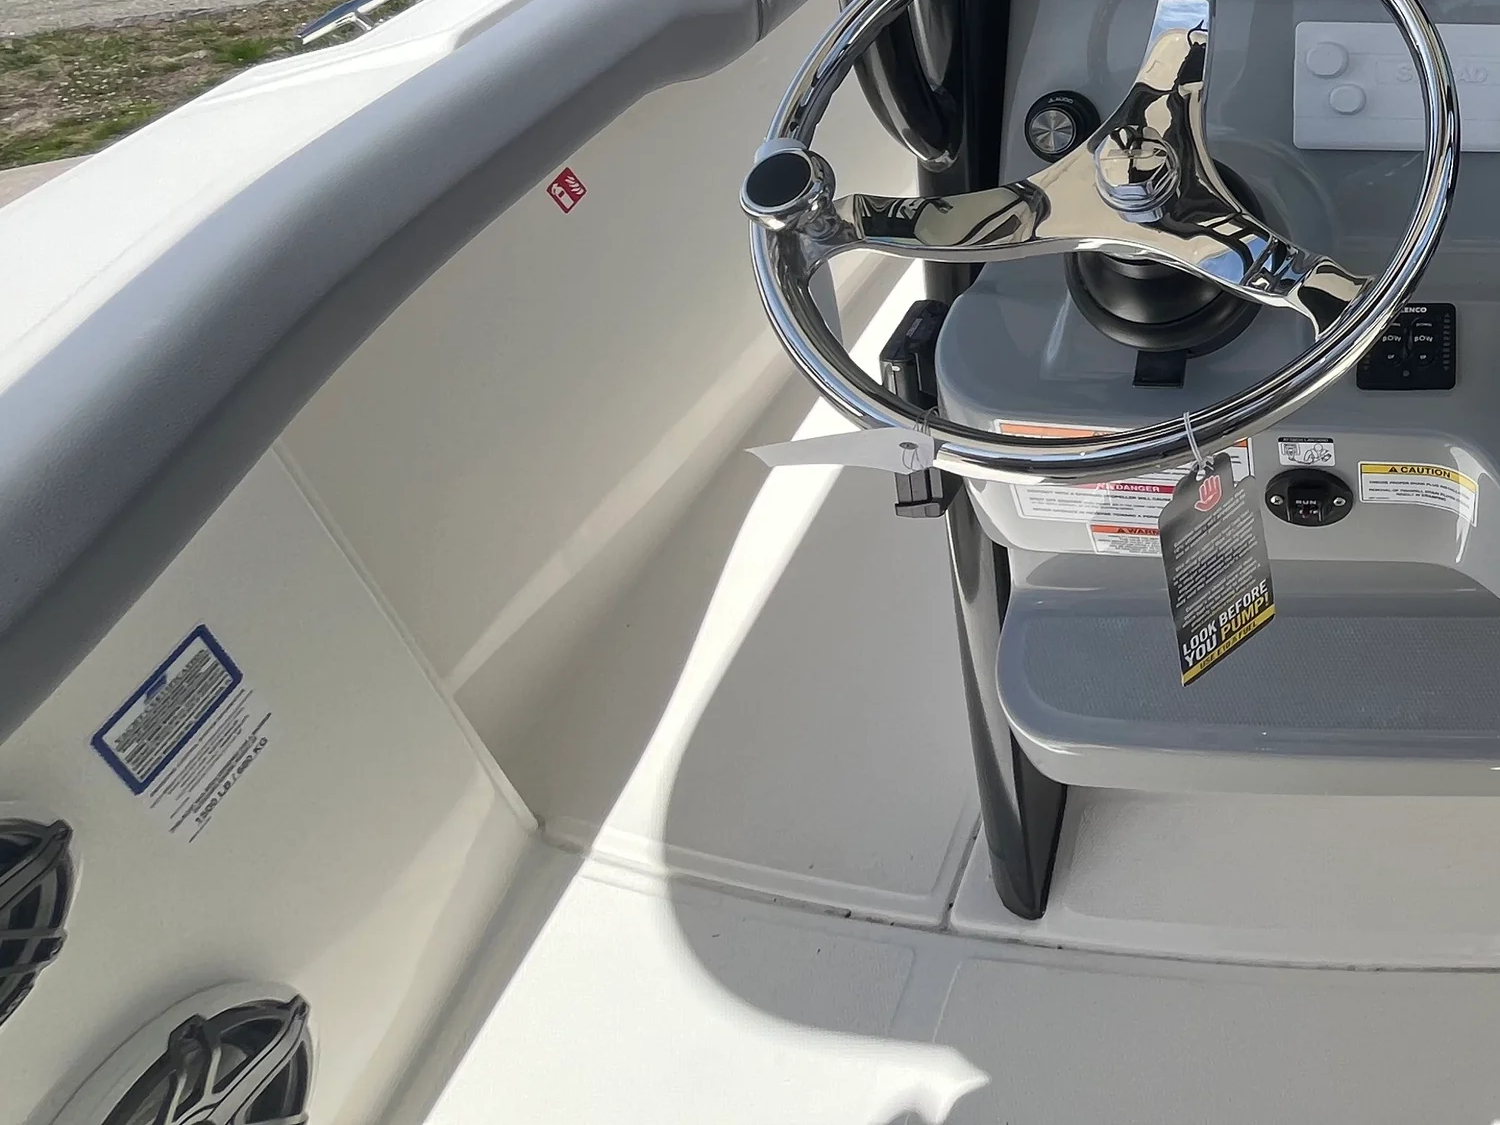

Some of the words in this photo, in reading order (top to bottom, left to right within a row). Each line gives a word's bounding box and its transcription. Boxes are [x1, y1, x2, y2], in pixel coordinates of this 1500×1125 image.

[1116, 483, 1160, 493] DANGER
[1401, 466, 1451, 478] CAUTION
[1183, 620, 1217, 655] LOOK
[1219, 579, 1268, 627] BEFORE
[1184, 634, 1217, 666] YOU
[1221, 592, 1269, 641] PUMP!
